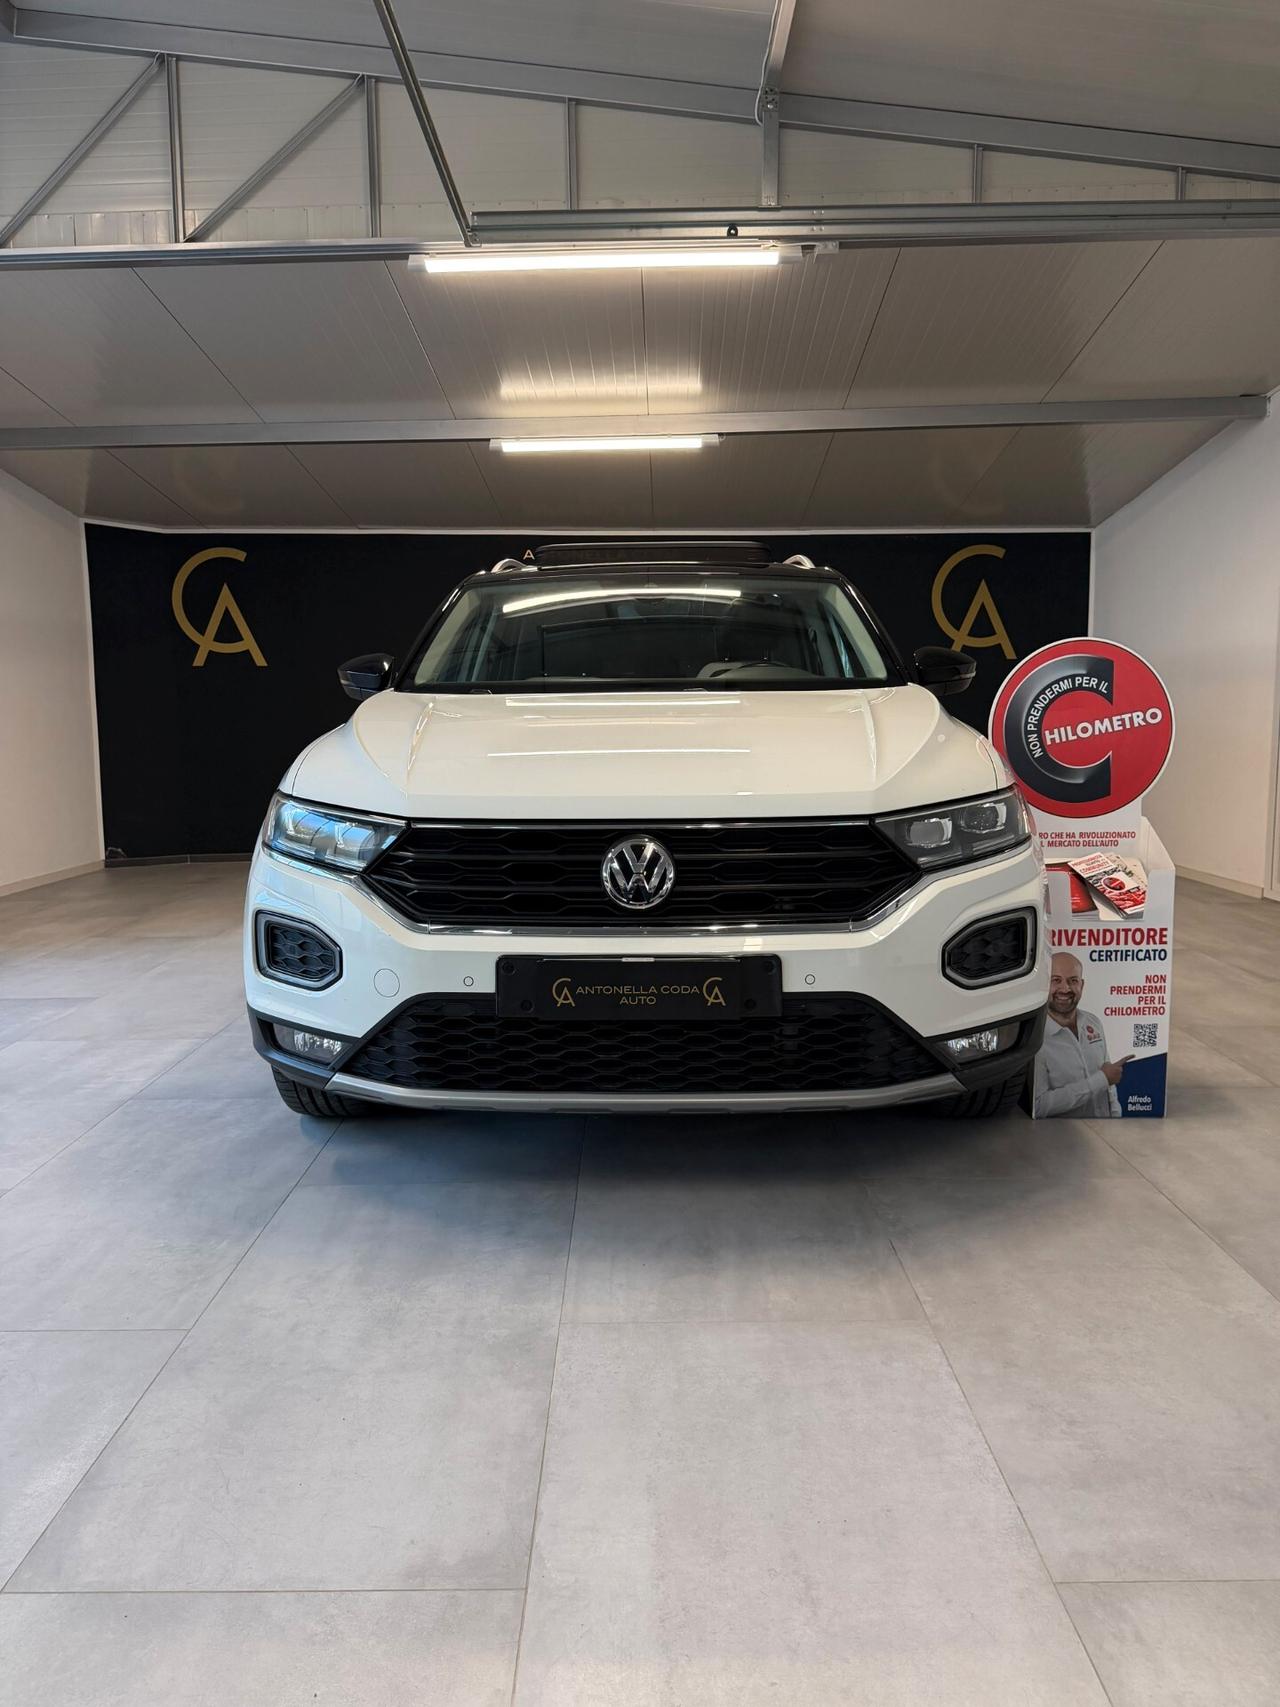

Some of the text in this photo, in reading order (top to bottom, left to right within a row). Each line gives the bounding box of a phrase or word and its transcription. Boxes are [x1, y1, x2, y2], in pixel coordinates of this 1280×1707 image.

[1027, 676, 1109, 758] NON PRENDERMI PER IL
[1050, 831, 1064, 840] CHE
[1065, 831, 1076, 840] HA
[1079, 831, 1136, 840] RIVOLUZIONATO
[1047, 840, 1081, 848] MERCATO
[1082, 840, 1119, 848] DELL'AUTO
[1051, 927, 1168, 947] RIVENDITORE
[1089, 949, 1167, 962] CERTIFICATO
[1145, 975, 1167, 984] NON
[575, 985, 658, 994] ANTONELLA
[660, 985, 700, 994] CODA
[1110, 985, 1166, 995] PRENDERMI
[619, 996, 657, 1005] AUTO
[1138, 996, 1166, 1005] PER IL
[1104, 1006, 1165, 1017] CHILOMETRO
[1128, 1096, 1152, 1104] Alfredo
[1127, 1103, 1153, 1112] Bellucci
